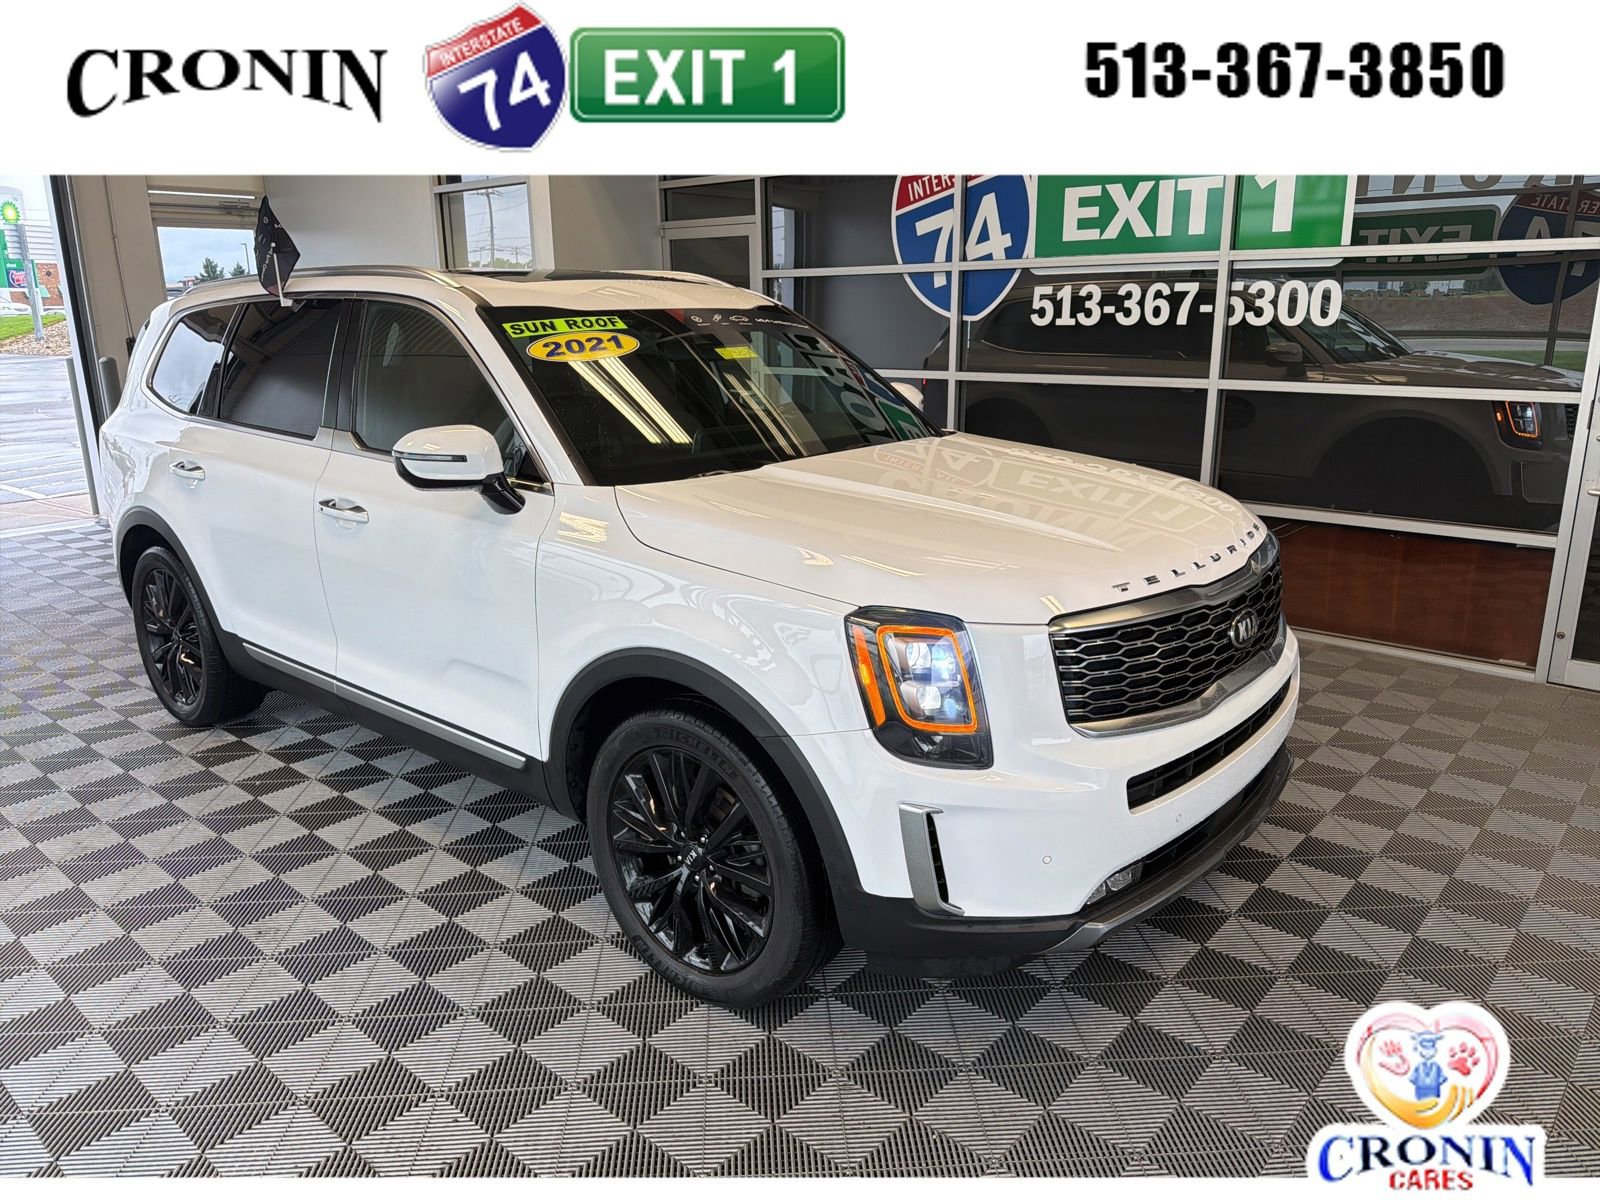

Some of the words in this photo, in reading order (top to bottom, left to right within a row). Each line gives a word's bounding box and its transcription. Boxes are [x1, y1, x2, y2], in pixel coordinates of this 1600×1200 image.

[908, 175, 955, 202] INTER
[1062, 176, 1225, 242] EXIT
[1254, 175, 1297, 233] 1
[915, 191, 1013, 289] 74
[1030, 279, 1343, 327] 513-367-5300
[509, 321, 557, 336] SUN
[564, 317, 621, 330] ROOF
[542, 334, 625, 358] 2021
[1112, 522, 1261, 592] TELLURIDE
[685, 849, 698, 865] KIA
